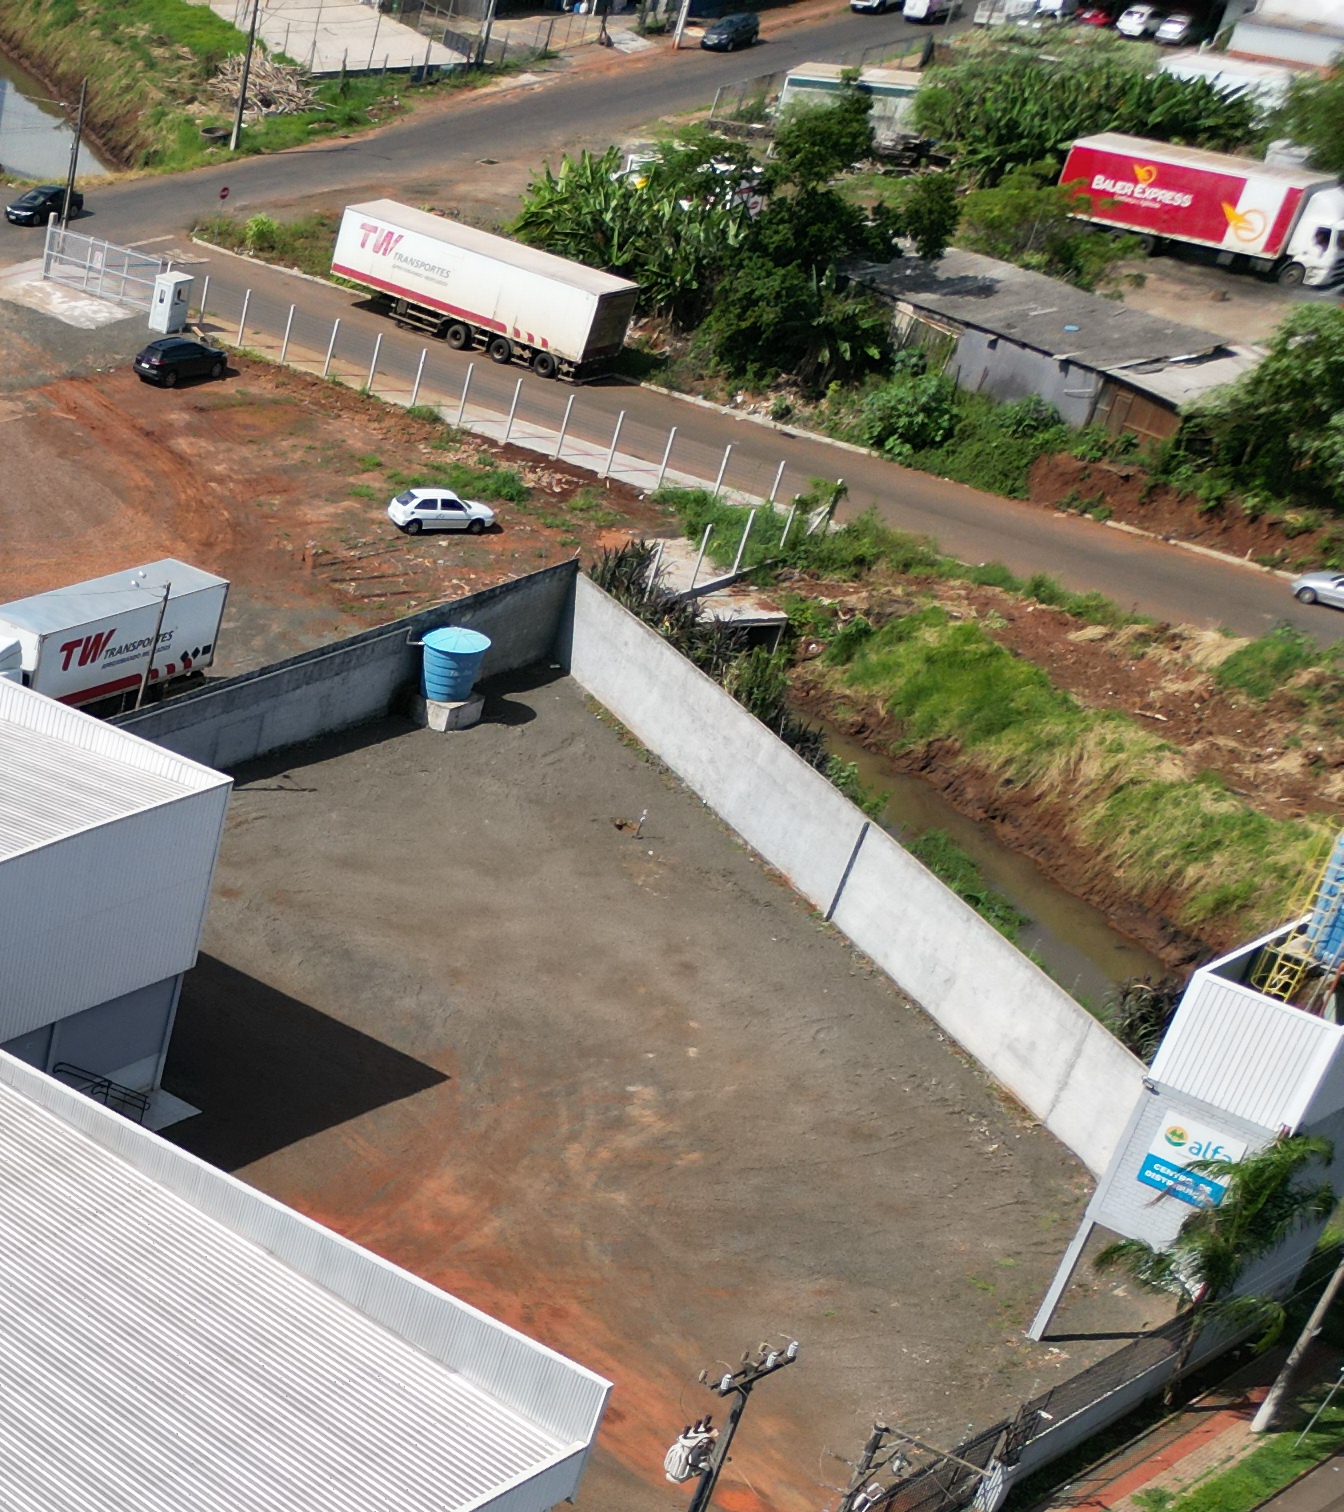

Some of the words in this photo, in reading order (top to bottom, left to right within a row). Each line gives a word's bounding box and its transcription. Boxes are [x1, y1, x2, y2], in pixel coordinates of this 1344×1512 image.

[1091, 174, 1134, 197] BAUER
[1133, 183, 1194, 208] EXPRESS
[360, 222, 404, 257] TW
[393, 251, 452, 279] TRANSPORTES
[59, 627, 117, 672] TW
[103, 630, 175, 660] TRANSPOTES
